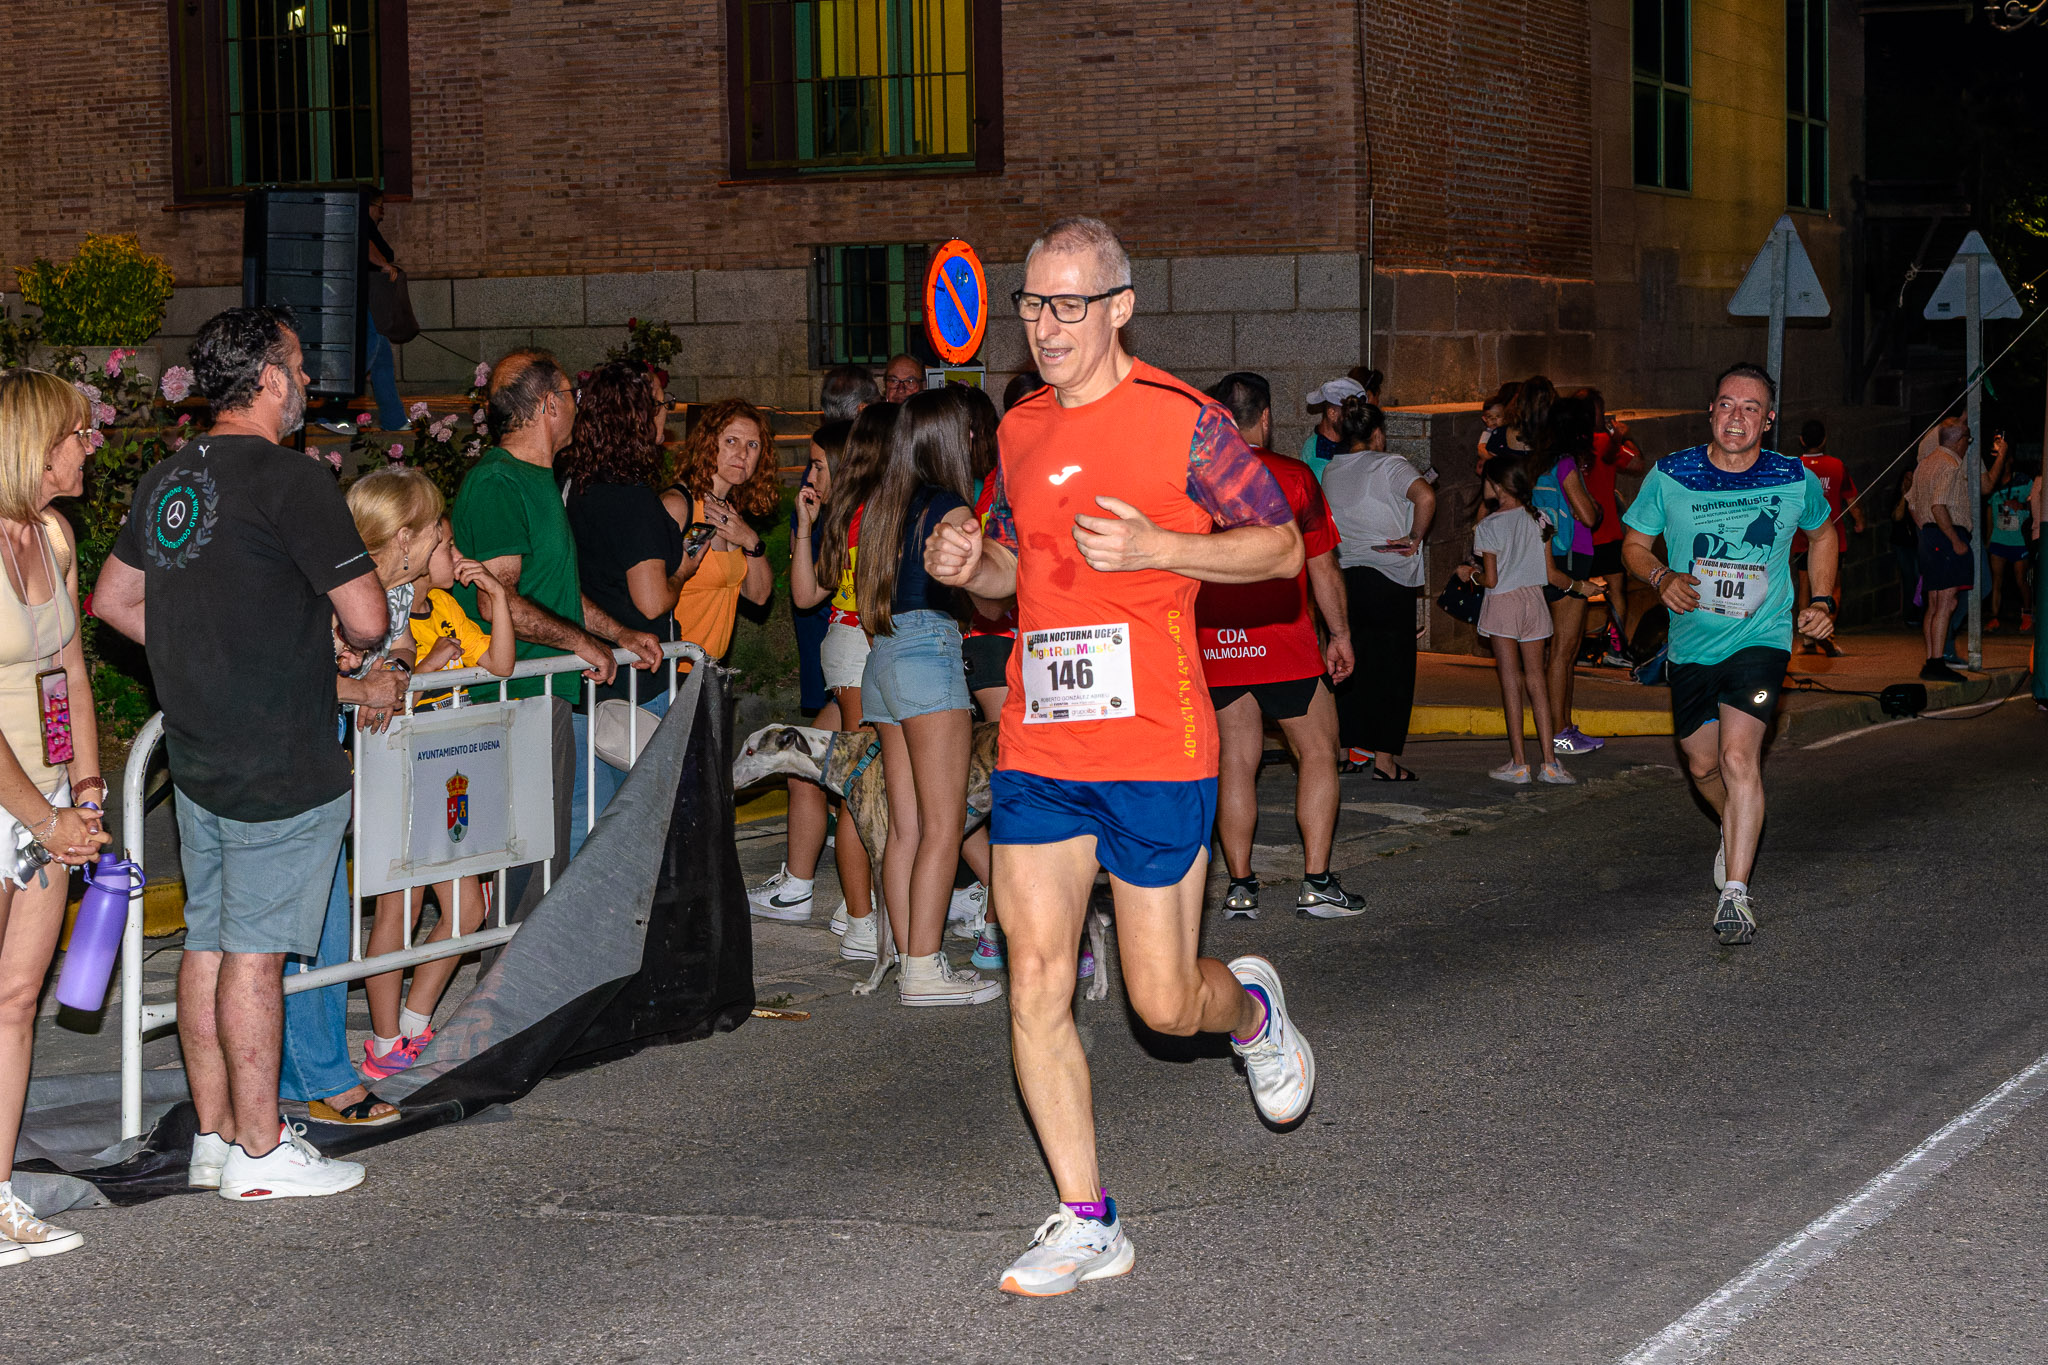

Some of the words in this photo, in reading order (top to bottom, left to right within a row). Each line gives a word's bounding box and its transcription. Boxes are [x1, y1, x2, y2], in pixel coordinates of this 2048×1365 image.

[188, 498, 199, 528] WORLD
[1714, 579, 1745, 600] 104
[1049, 629, 1092, 642] NOCTURNA
[1217, 628, 1248, 644] CDA
[1203, 645, 1267, 660] VALMOJADO
[1047, 658, 1094, 691] 146
[417, 744, 468, 761] AYUNTAMIENTO
[469, 743, 478, 753] DE
[478, 739, 500, 751] UGENA
